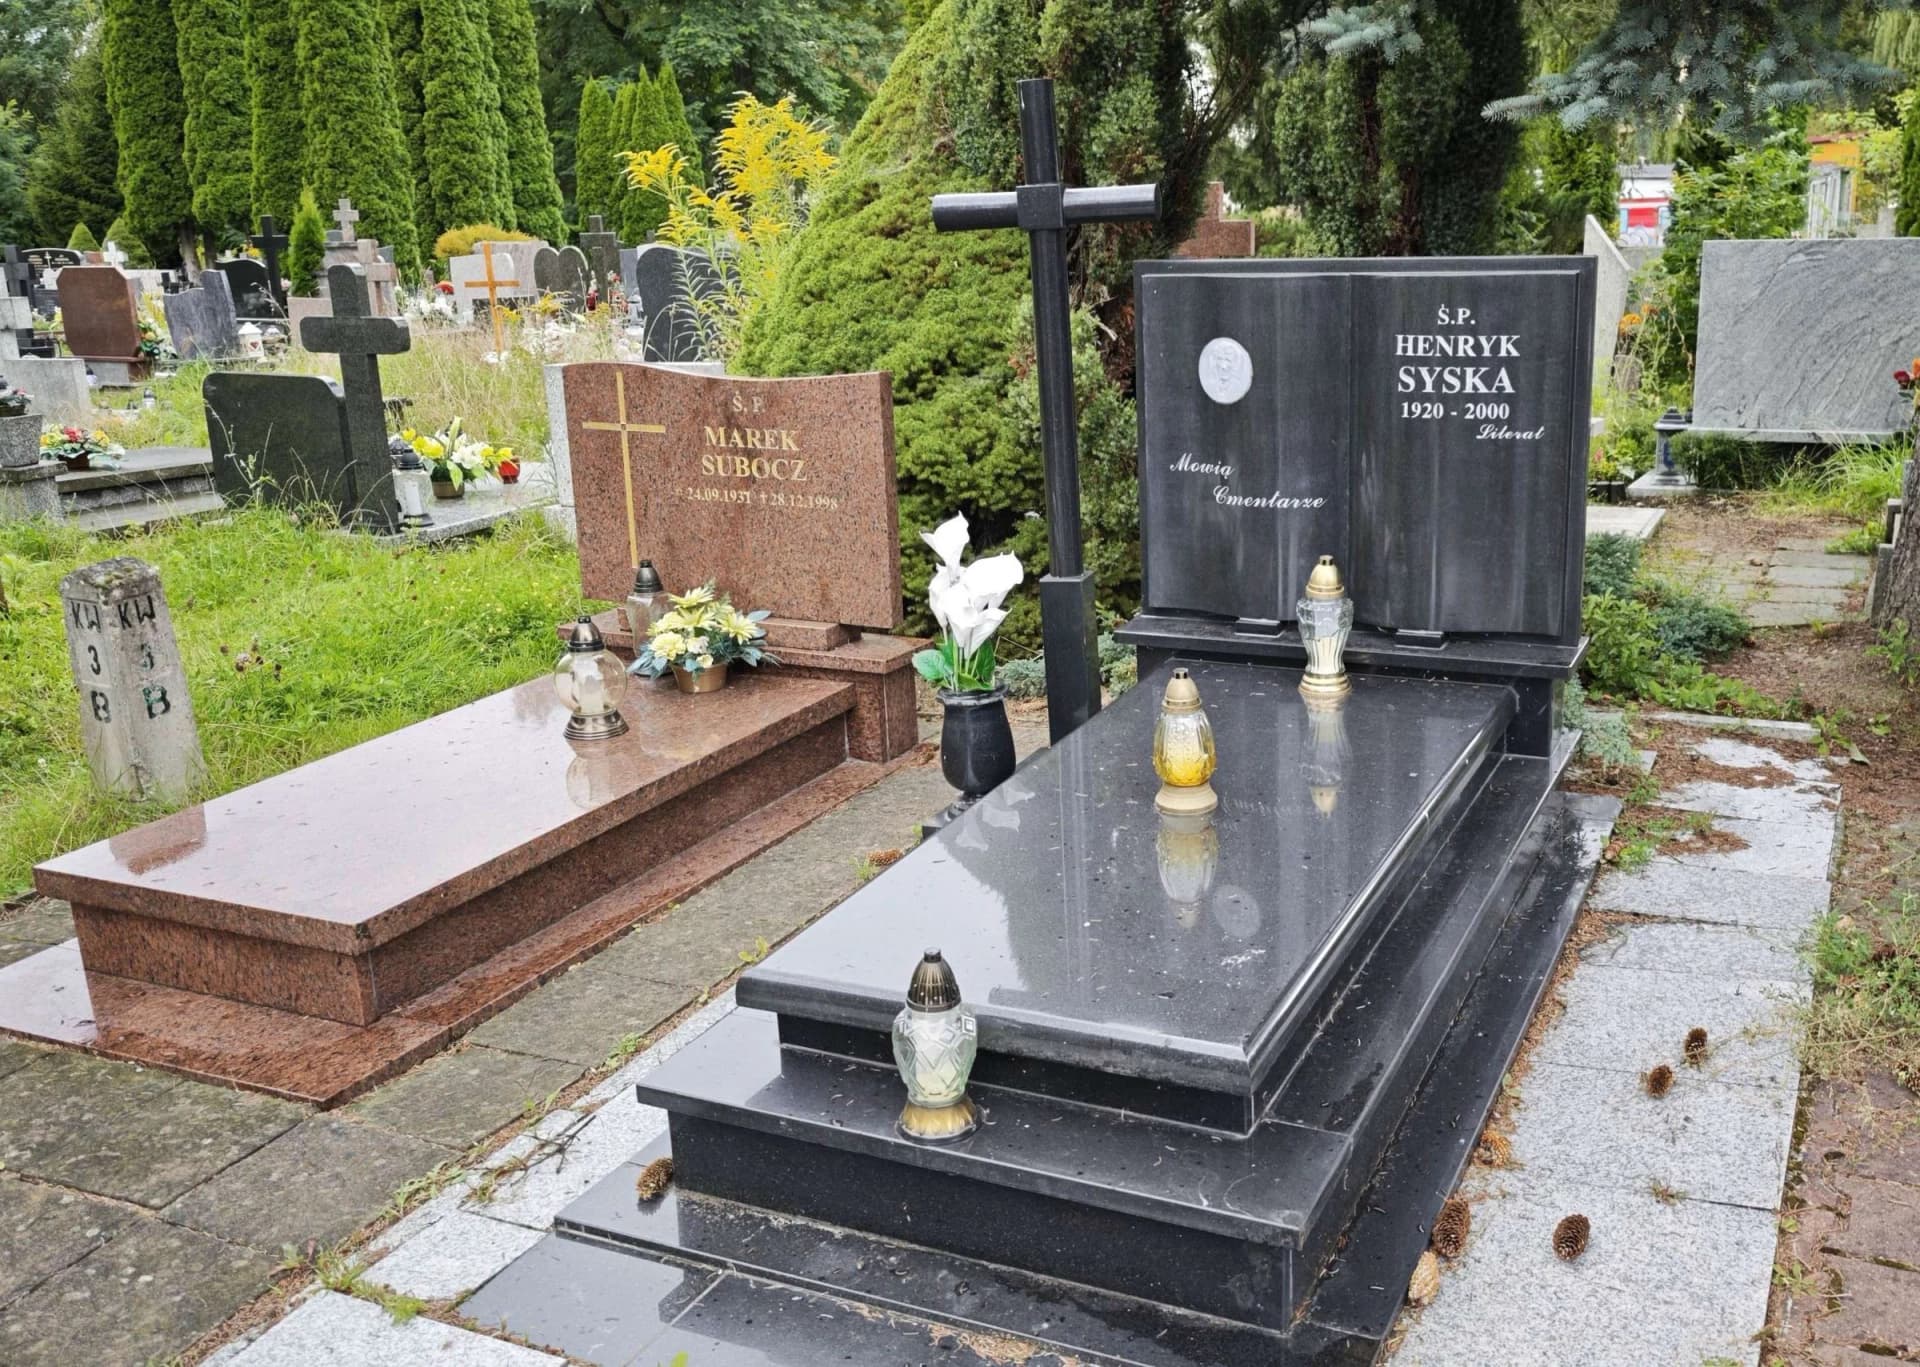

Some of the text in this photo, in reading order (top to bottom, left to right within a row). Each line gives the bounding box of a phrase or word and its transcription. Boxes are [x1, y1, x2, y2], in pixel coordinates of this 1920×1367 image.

[1394, 334, 1521, 357] HENRYK
[1398, 366, 1516, 393] SYSKA
[1400, 402, 1444, 419] 1920
[1464, 403, 1510, 419] 2000
[704, 426, 800, 450] MAREK
[1475, 424, 1545, 440] Literat
[702, 455, 807, 480] SUBOCZ
[1169, 453, 1235, 480] Mowią
[1213, 485, 1329, 509] Cmentarze
[71, 601, 102, 633] KW
[118, 595, 157, 630] KW
[88, 645, 101, 675] 3
[143, 686, 171, 719] B
